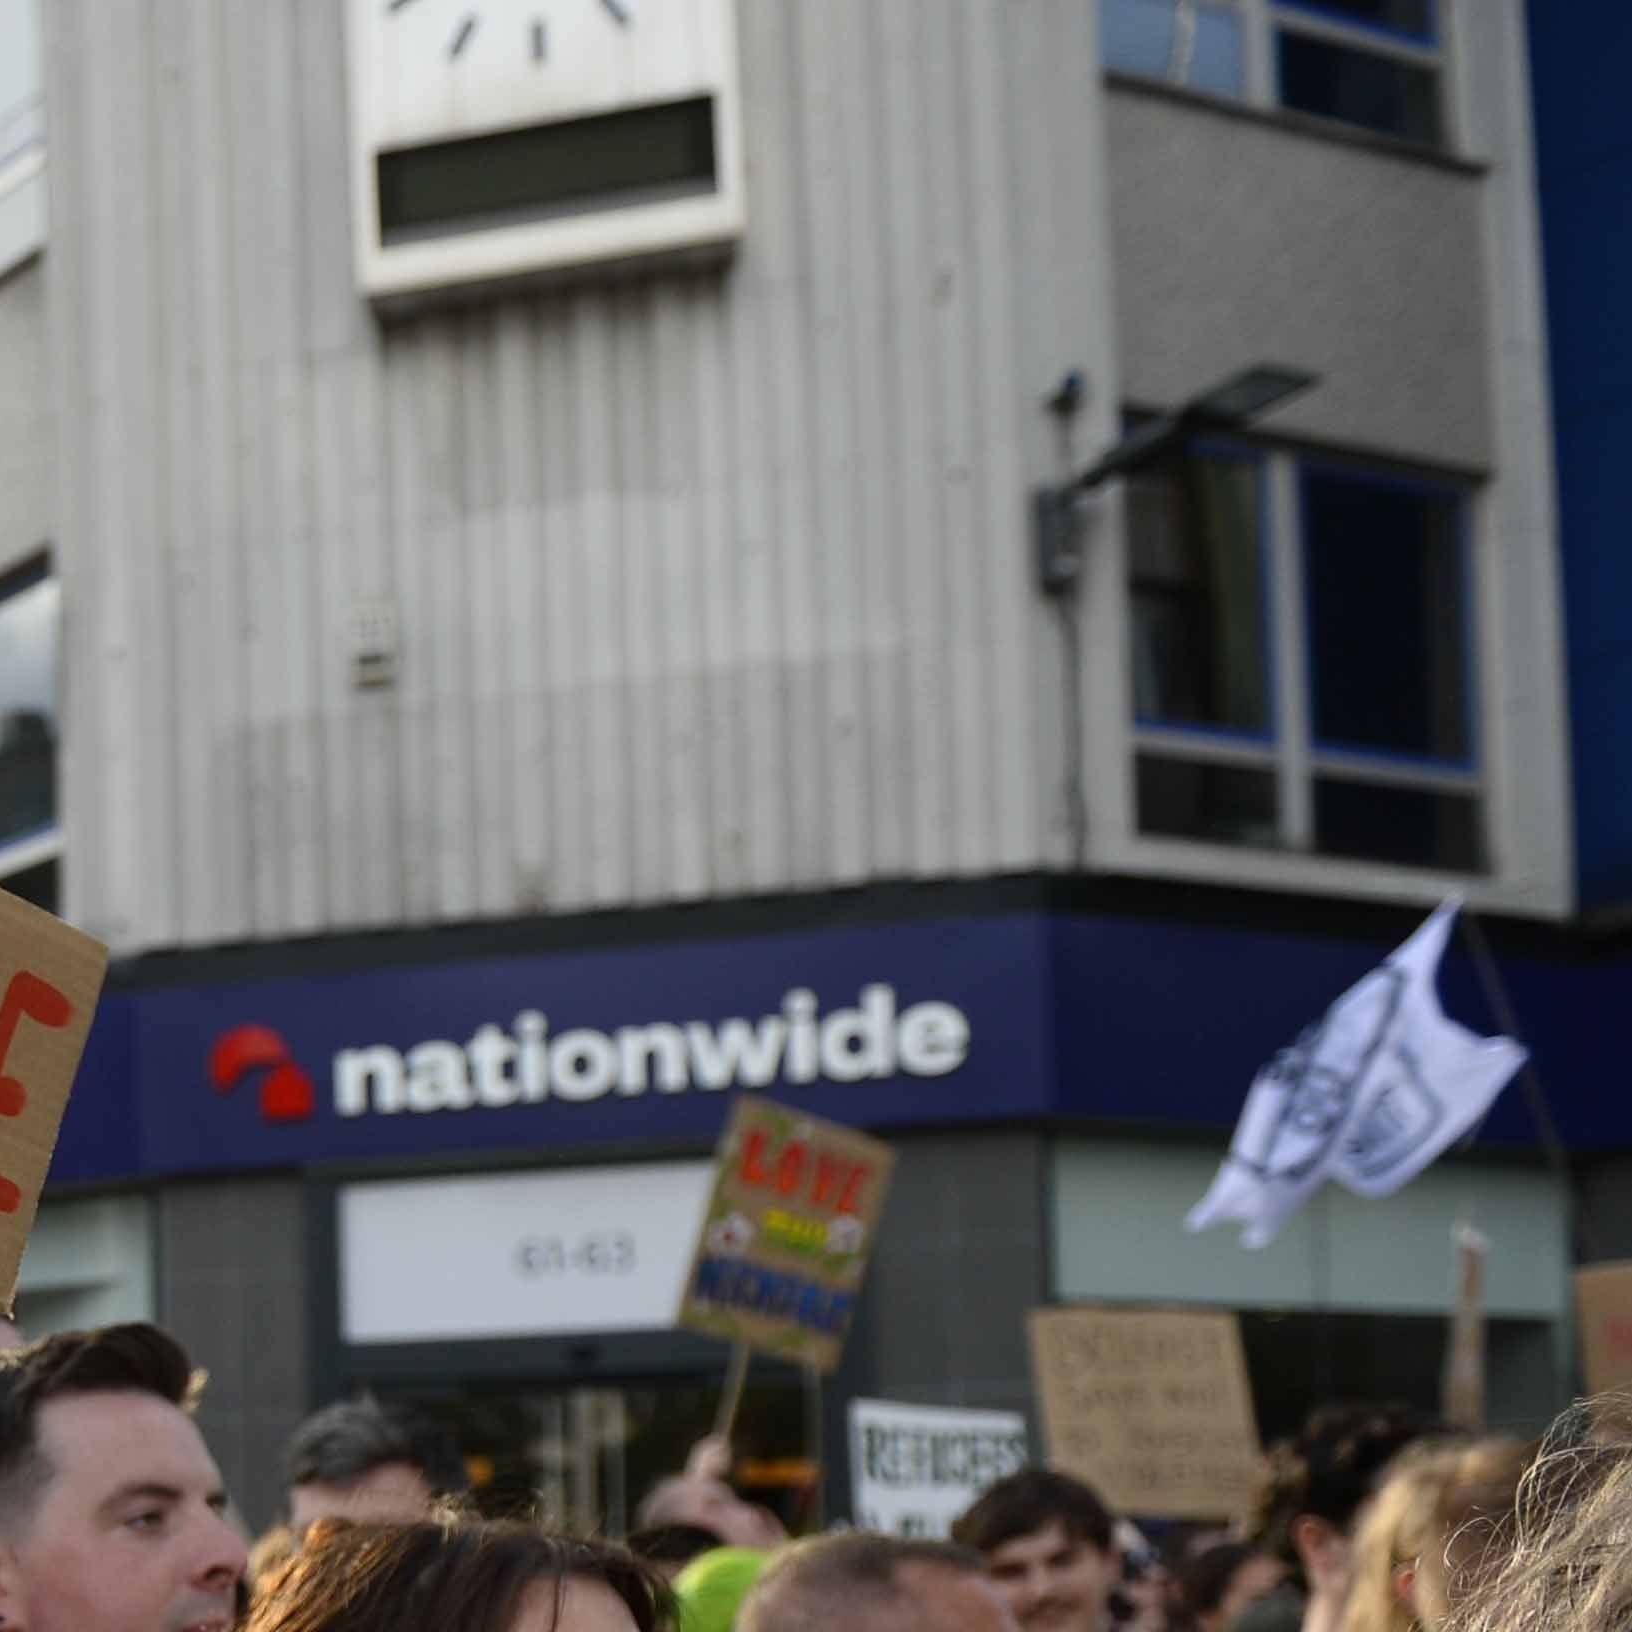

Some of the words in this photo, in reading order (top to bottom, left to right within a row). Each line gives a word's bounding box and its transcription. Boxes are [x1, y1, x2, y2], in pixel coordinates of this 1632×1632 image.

[334, 983, 970, 1117] nationwide
[739, 1124, 873, 1216] LOVE
[513, 1231, 637, 1279] 61-63
